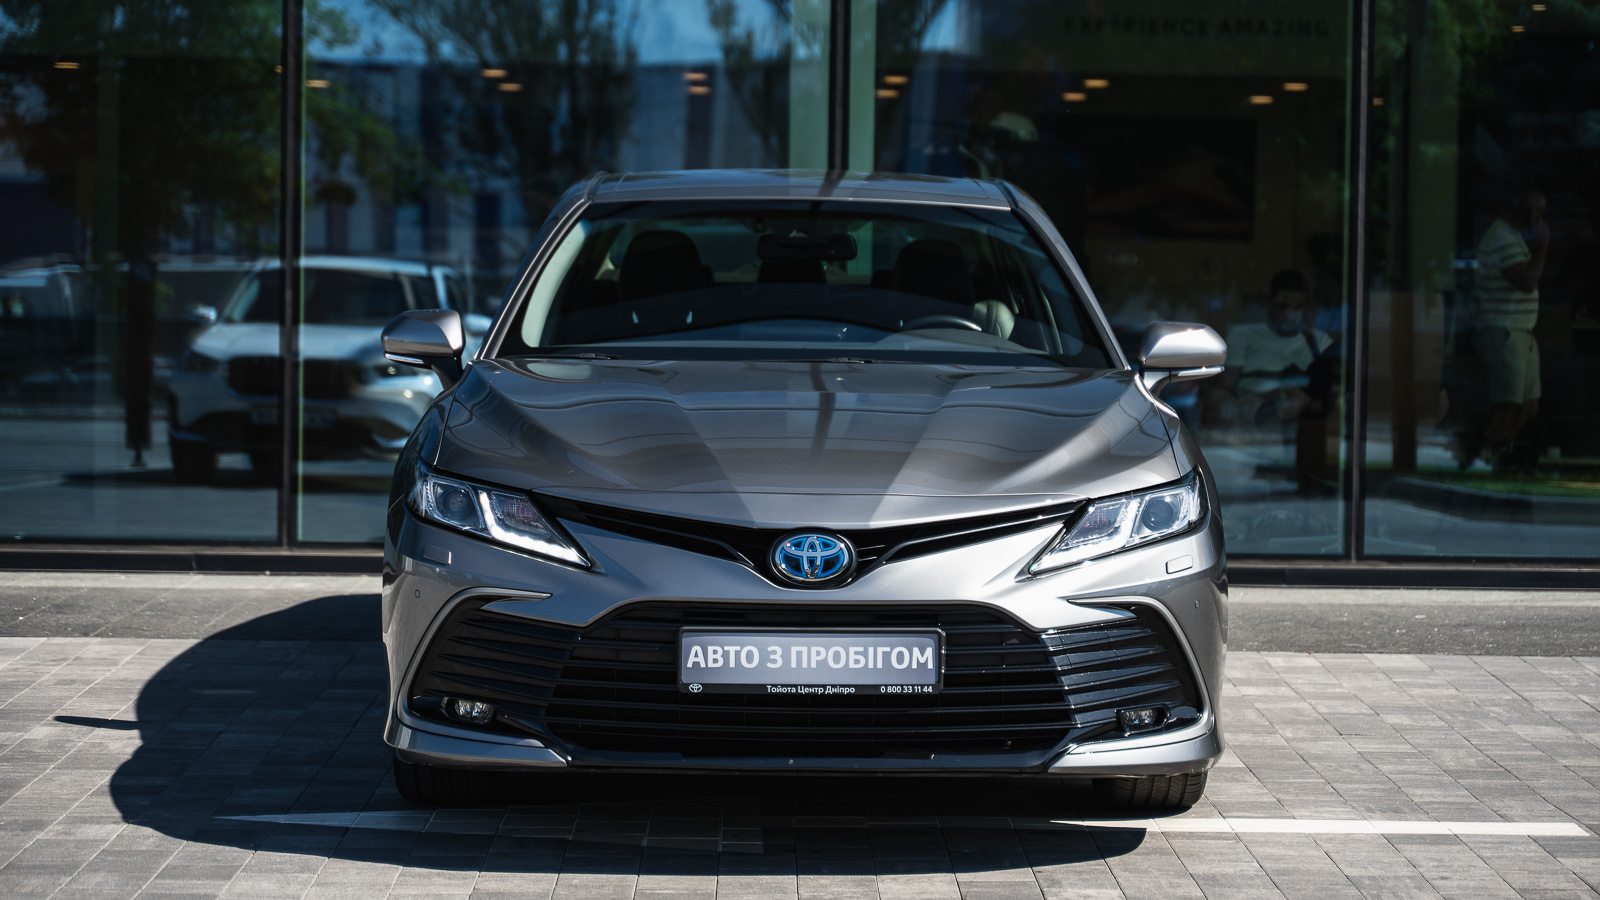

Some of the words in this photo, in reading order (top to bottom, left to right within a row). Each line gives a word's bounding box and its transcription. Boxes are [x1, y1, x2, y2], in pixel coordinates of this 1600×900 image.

[1063, 16, 1209, 36] EXPERIENCE
[1218, 18, 1331, 37] AMAZING
[686, 645, 760, 669] АВТО
[790, 646, 934, 669] ПРОБІГОМ
[766, 685, 796, 694] Тойота
[797, 685, 824, 695] Центр
[825, 685, 855, 695] Дніпро
[880, 685, 886, 694] 0
[886, 685, 902, 694] 800
[902, 685, 913, 694] 33
[914, 685, 922, 694] 11
[923, 685, 933, 694] 44
